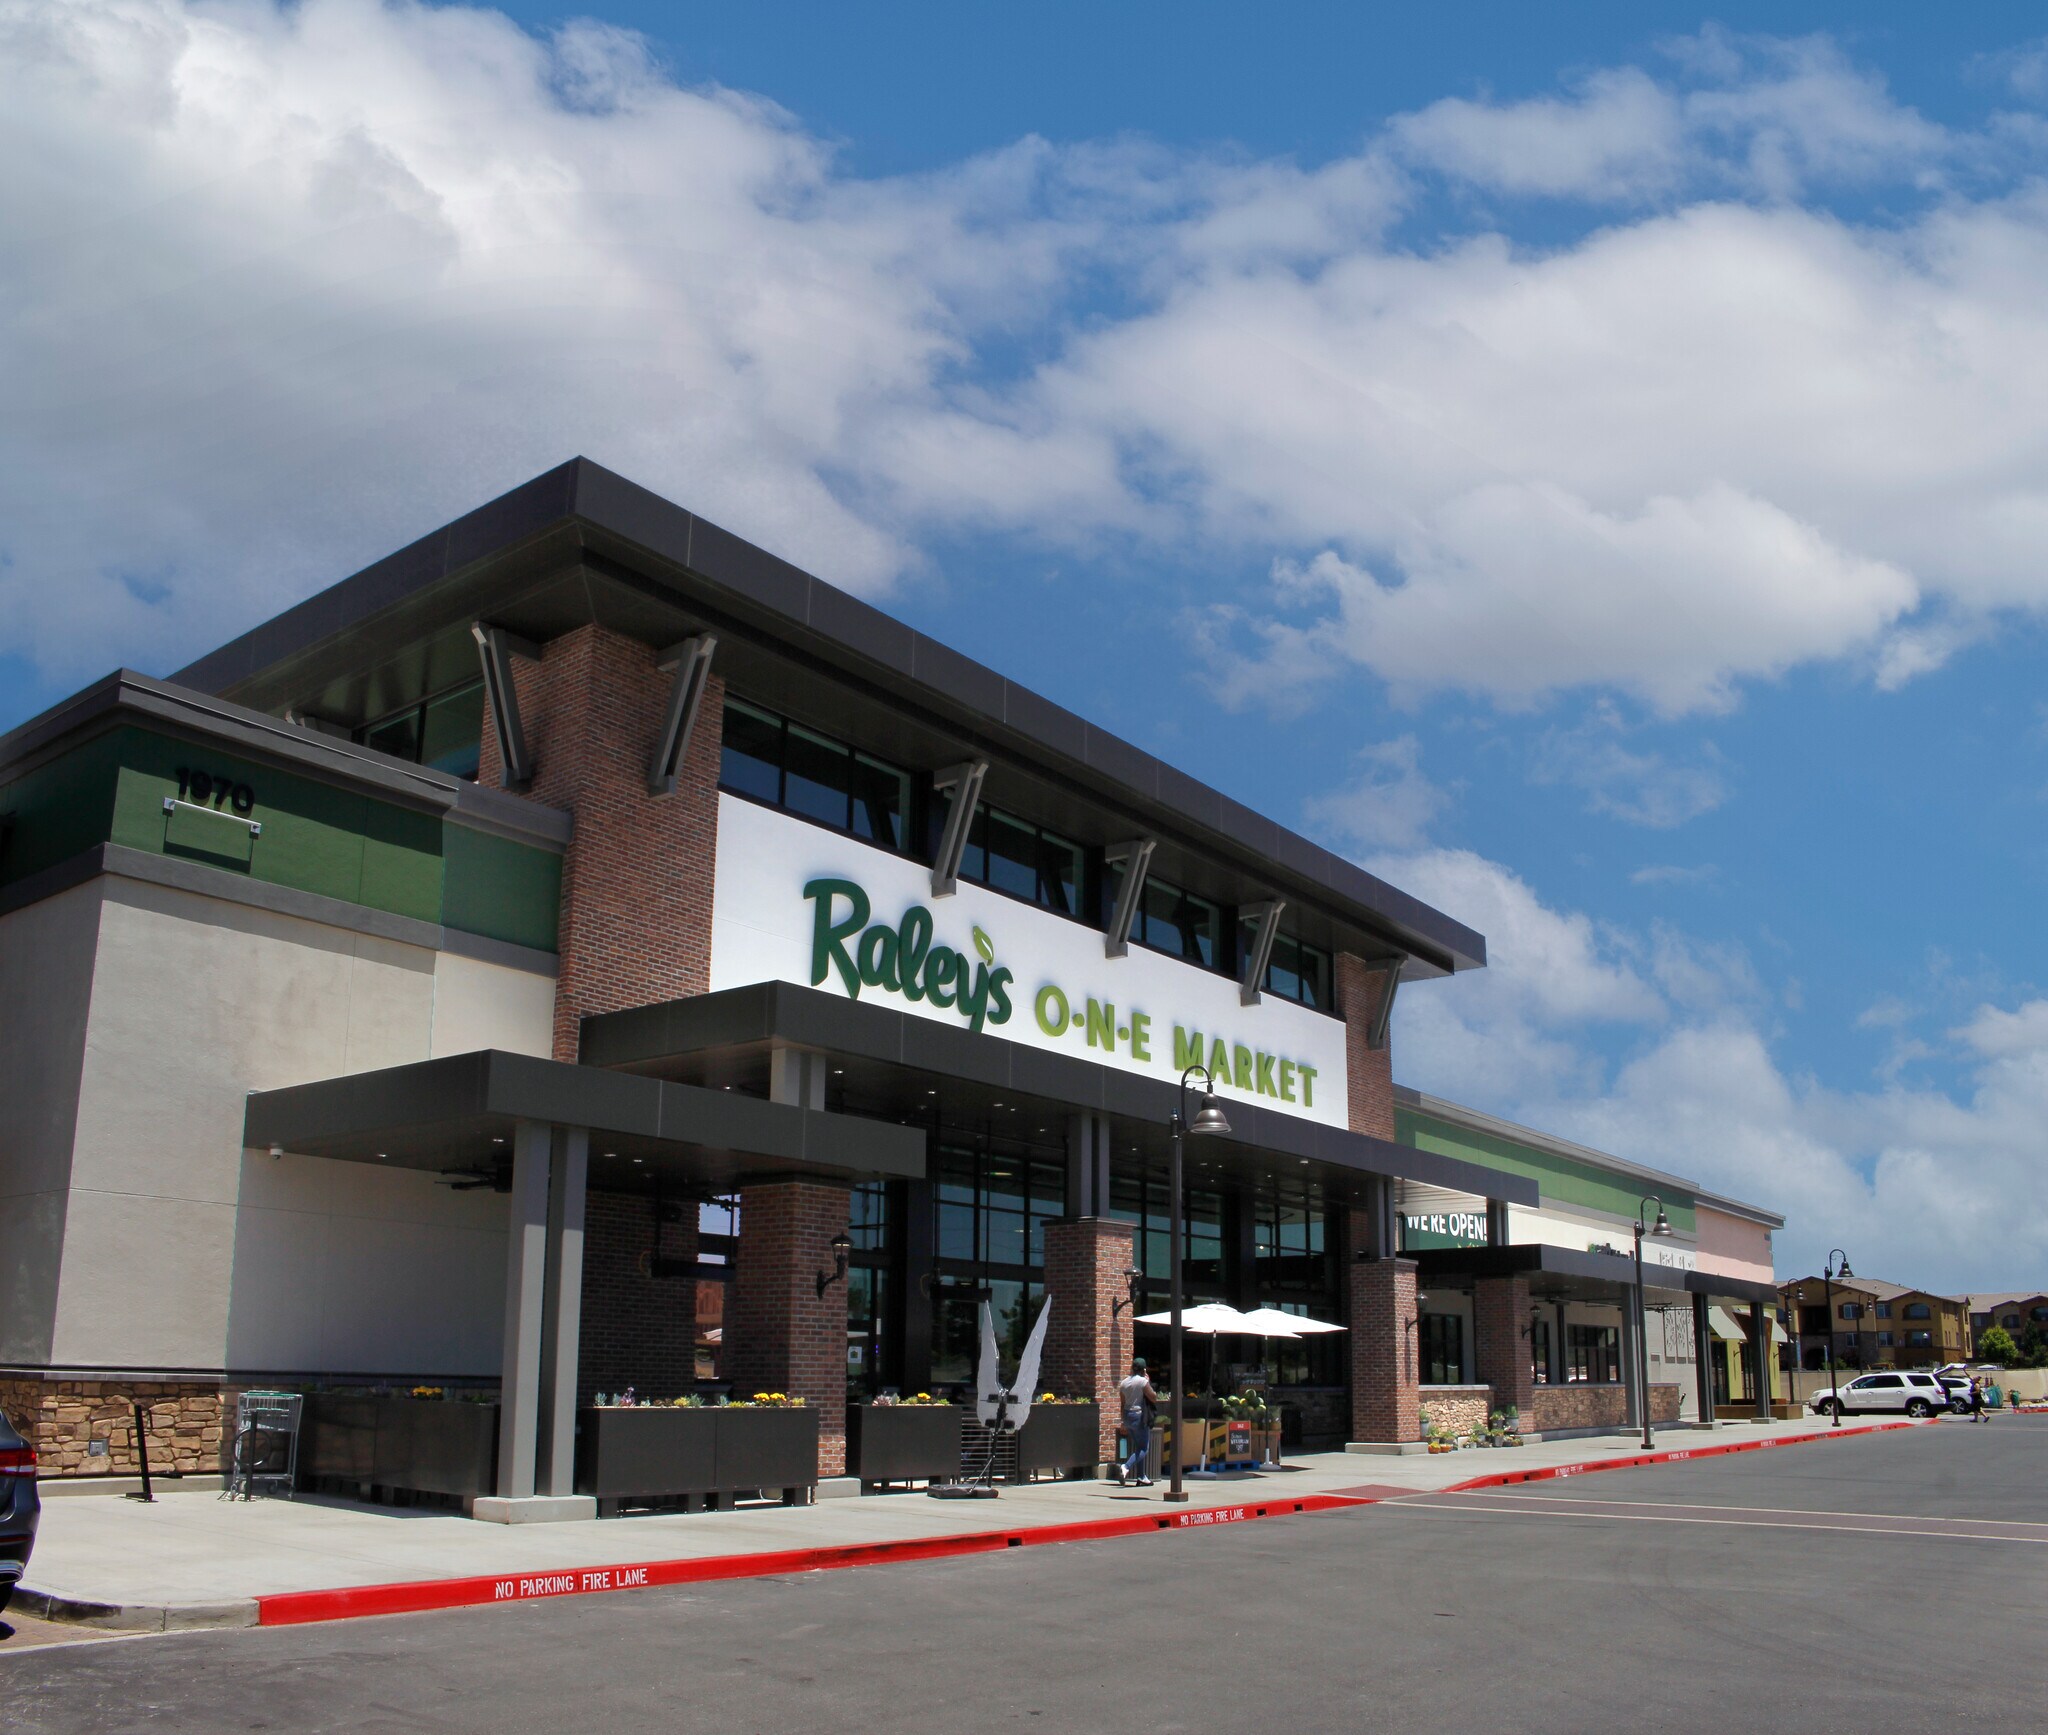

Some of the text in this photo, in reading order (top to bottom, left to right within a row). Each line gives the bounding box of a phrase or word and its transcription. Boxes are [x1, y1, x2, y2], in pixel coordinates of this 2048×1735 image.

[175, 767, 255, 813] 1970
[803, 878, 1014, 1033] Raley's
[1174, 1025, 1318, 1107] MARKET
[1407, 1213, 1487, 1242] WERE OPEN!
[1216, 1510, 1228, 1522] FIRE
[495, 1568, 648, 1599] NO PARKING FIRE LANE
